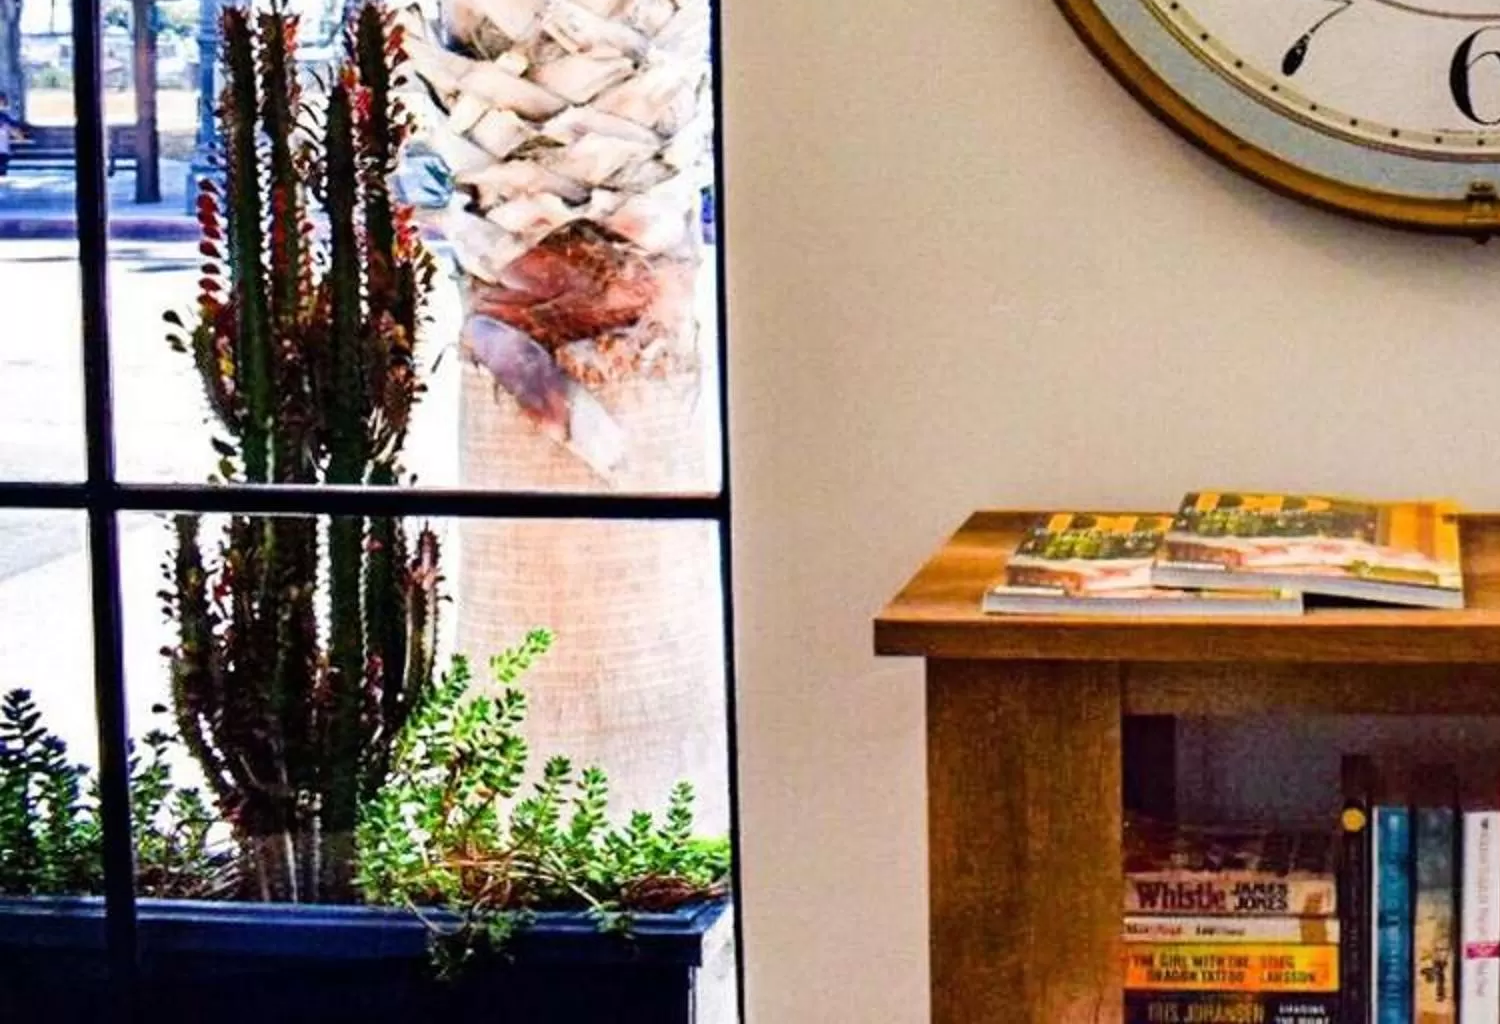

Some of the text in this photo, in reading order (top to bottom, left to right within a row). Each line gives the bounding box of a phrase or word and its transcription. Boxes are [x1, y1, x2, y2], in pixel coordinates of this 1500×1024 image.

[1134, 879, 1227, 911] Whistle
[1231, 881, 1288, 895] JAMES
[1232, 895, 1288, 911] JONES
